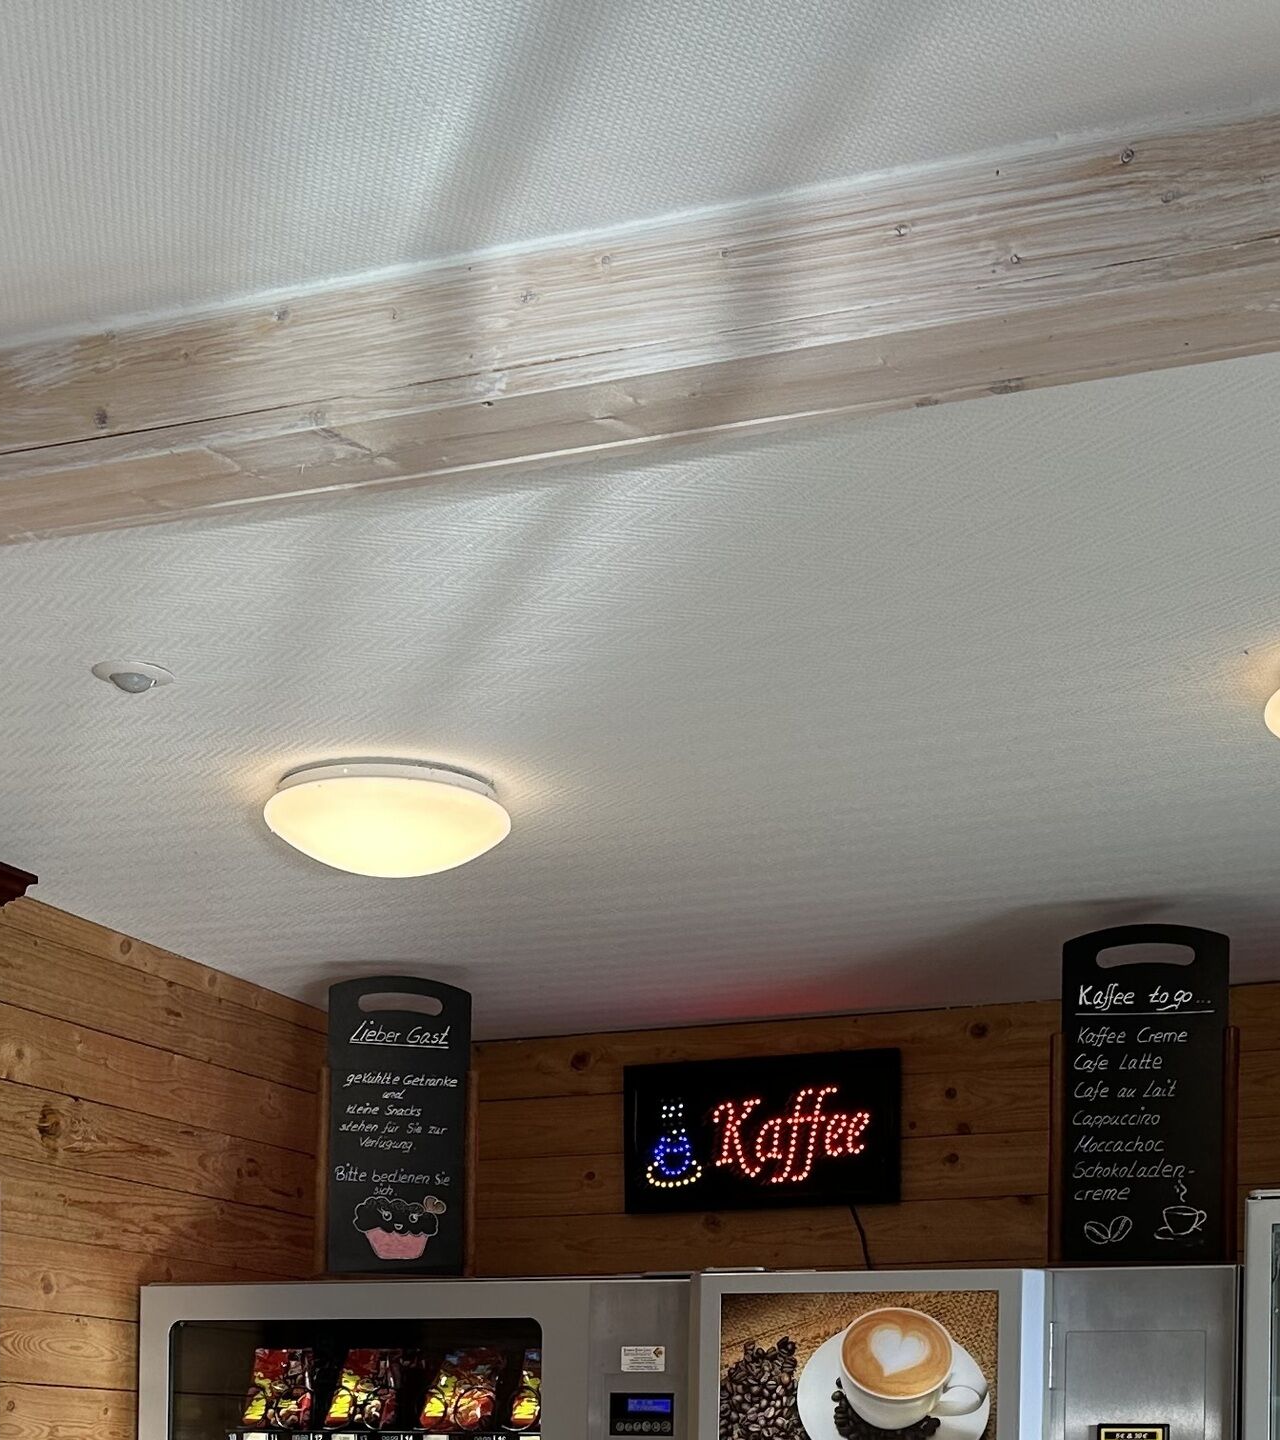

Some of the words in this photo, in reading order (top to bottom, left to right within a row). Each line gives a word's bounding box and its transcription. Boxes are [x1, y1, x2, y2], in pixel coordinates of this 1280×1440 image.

[1078, 983, 1135, 1011] Kaffee
[1149, 985, 1169, 1004] to
[350, 1020, 401, 1044] Lieber
[406, 1026, 450, 1046] Gast
[1077, 1026, 1126, 1047] Kaffee
[1137, 1027, 1188, 1043] Creme
[1074, 1053, 1109, 1072] Cafe
[1119, 1054, 1162, 1070] Latte
[382, 1089, 406, 1100] und
[1074, 1080, 1110, 1101] Cafe
[1116, 1088, 1137, 1098] au
[1143, 1079, 1177, 1098] Lait
[384, 1105, 422, 1117] Snacks
[1072, 1106, 1161, 1128] Cappuccino
[339, 1120, 378, 1132] stehen
[381, 1122, 399, 1135] für
[407, 1122, 423, 1134] Sie
[428, 1126, 448, 1135] zur
[711, 1087, 871, 1184] Kaffee
[1074, 1135, 1165, 1152] Moccachoc
[335, 1163, 367, 1182] Bitte
[372, 1168, 430, 1184] bedienen
[1074, 1186, 1131, 1201] creme
